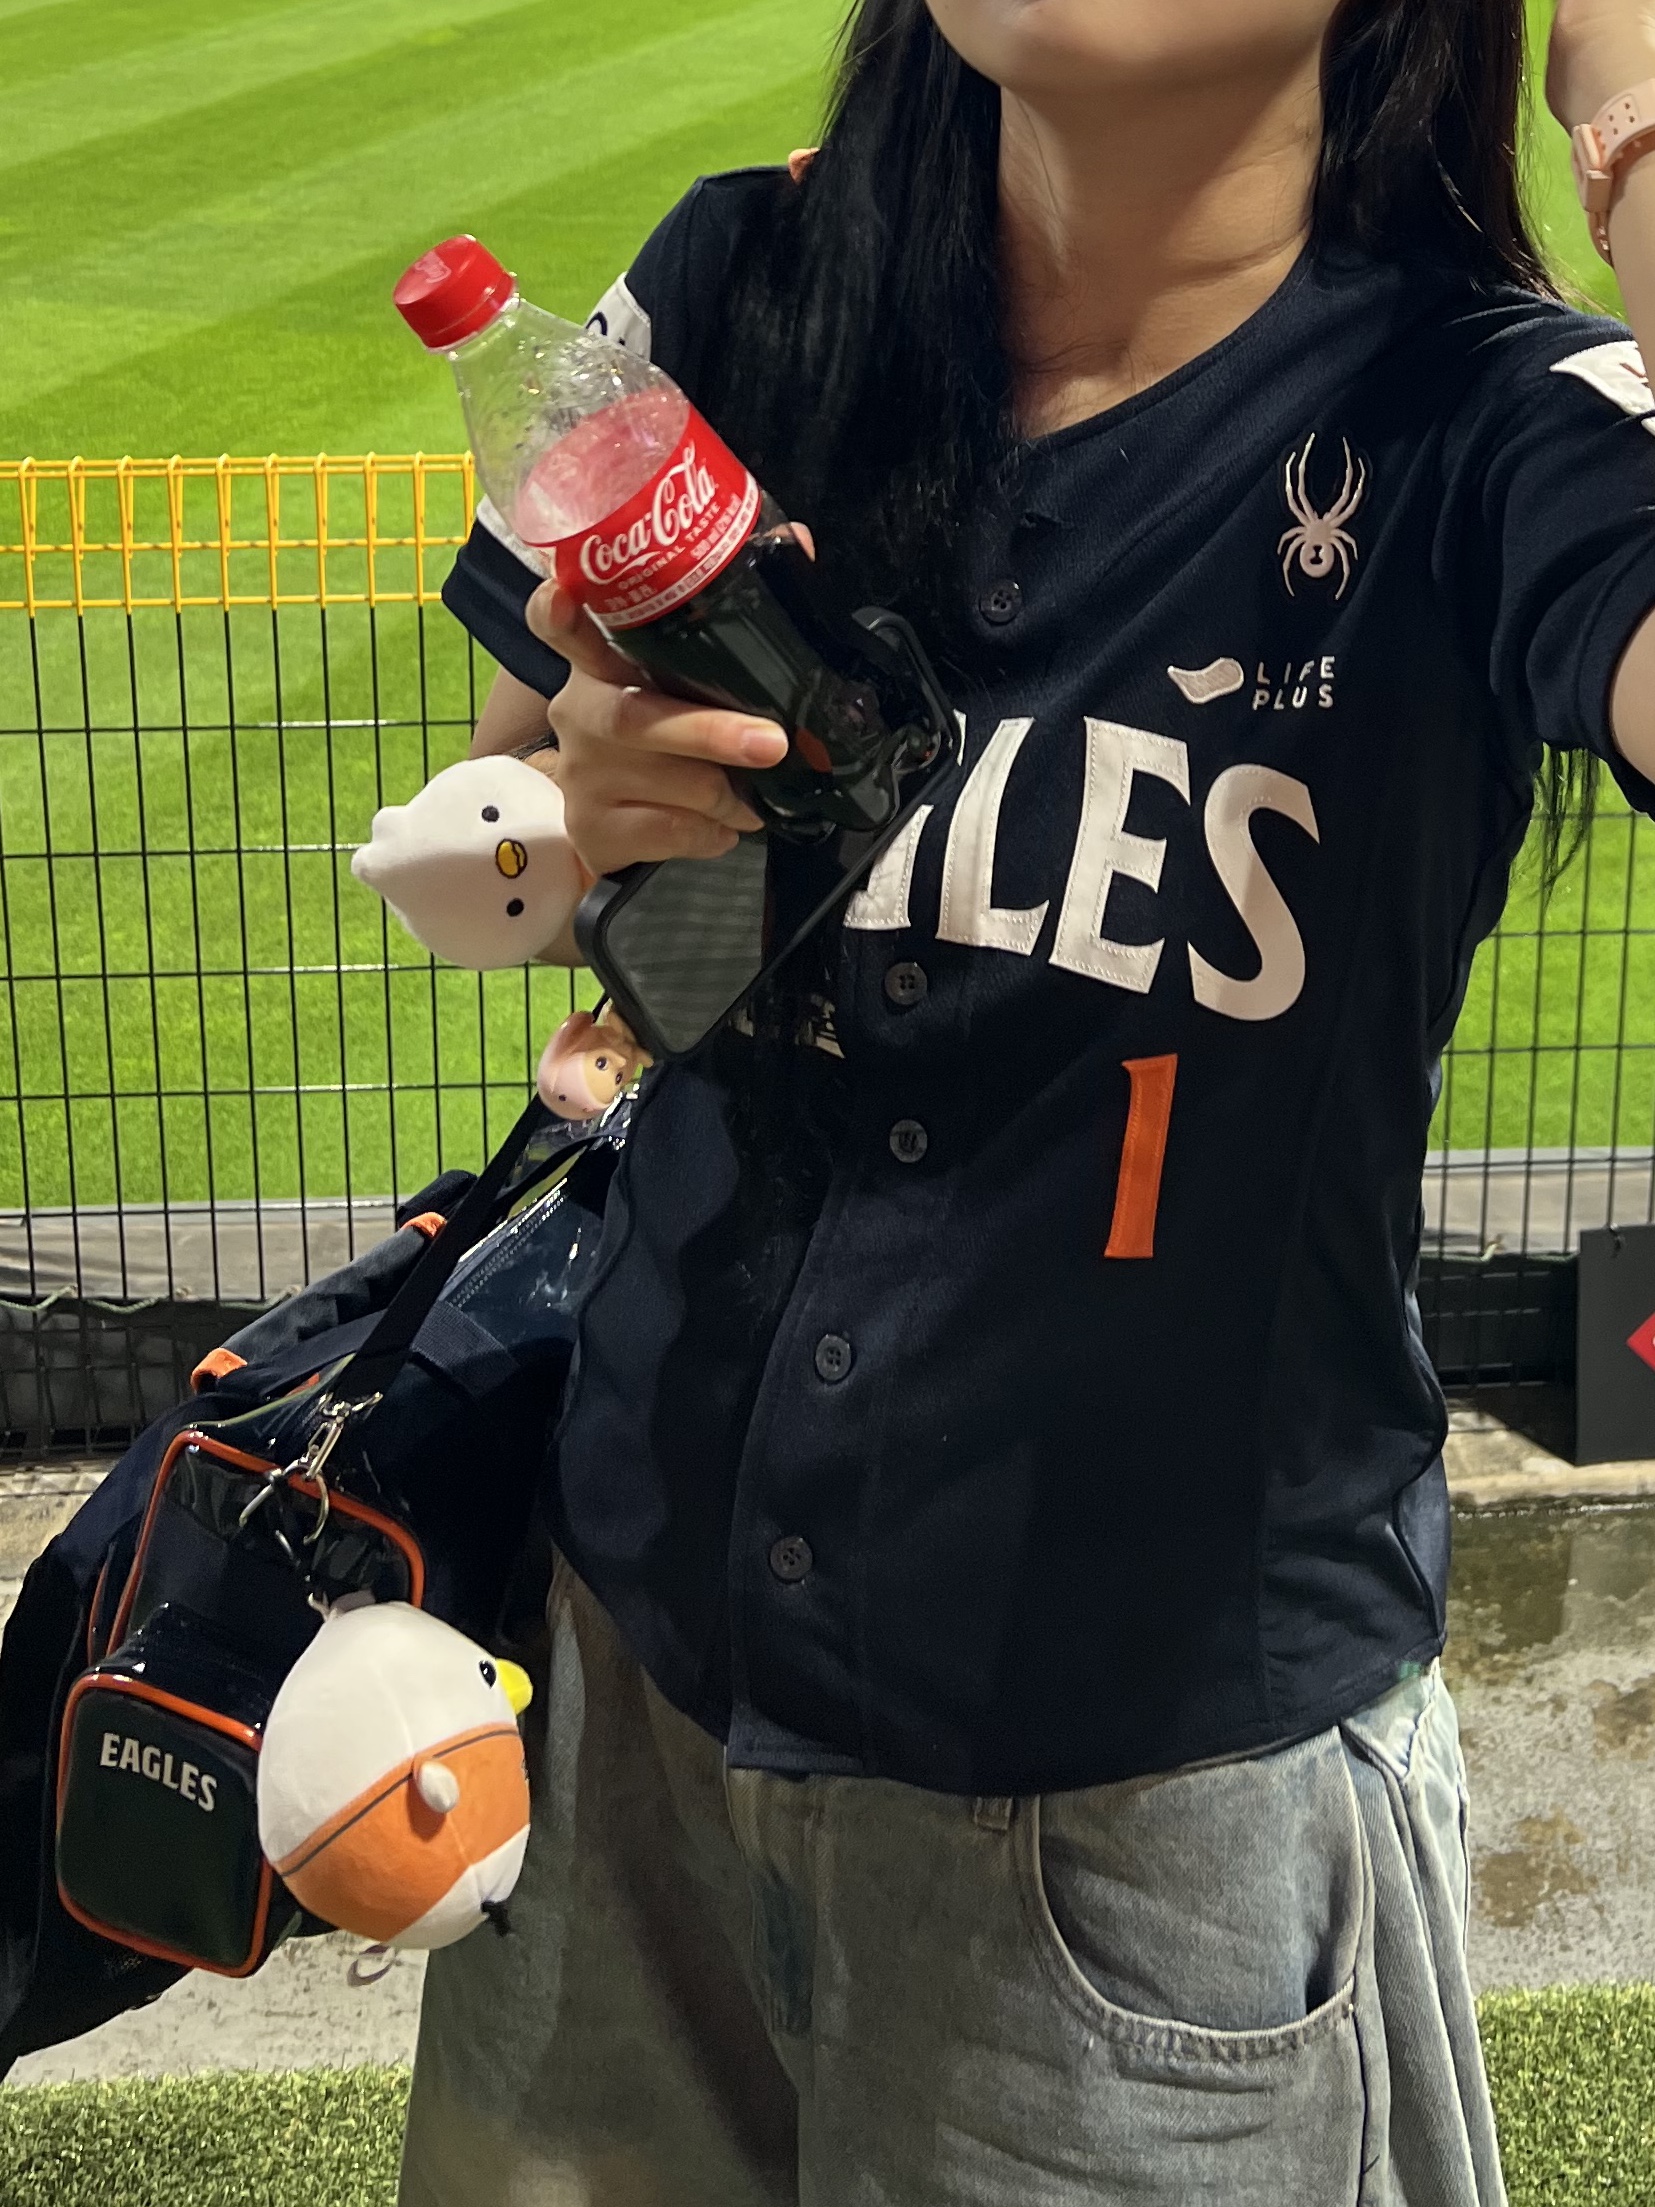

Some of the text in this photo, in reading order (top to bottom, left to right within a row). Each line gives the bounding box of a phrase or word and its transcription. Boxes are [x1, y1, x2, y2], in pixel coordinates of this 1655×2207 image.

[579, 439, 718, 586] Coca-Cola
[618, 545, 686, 589] ORIGINAL
[685, 501, 721, 542] TASTE
[1252, 684, 1334, 710] PLUS
[1257, 655, 1335, 685] LIFE
[843, 707, 1320, 1021] LES
[1104, 1053, 1178, 1260] 1
[100, 1732, 218, 1812] EAGLES
